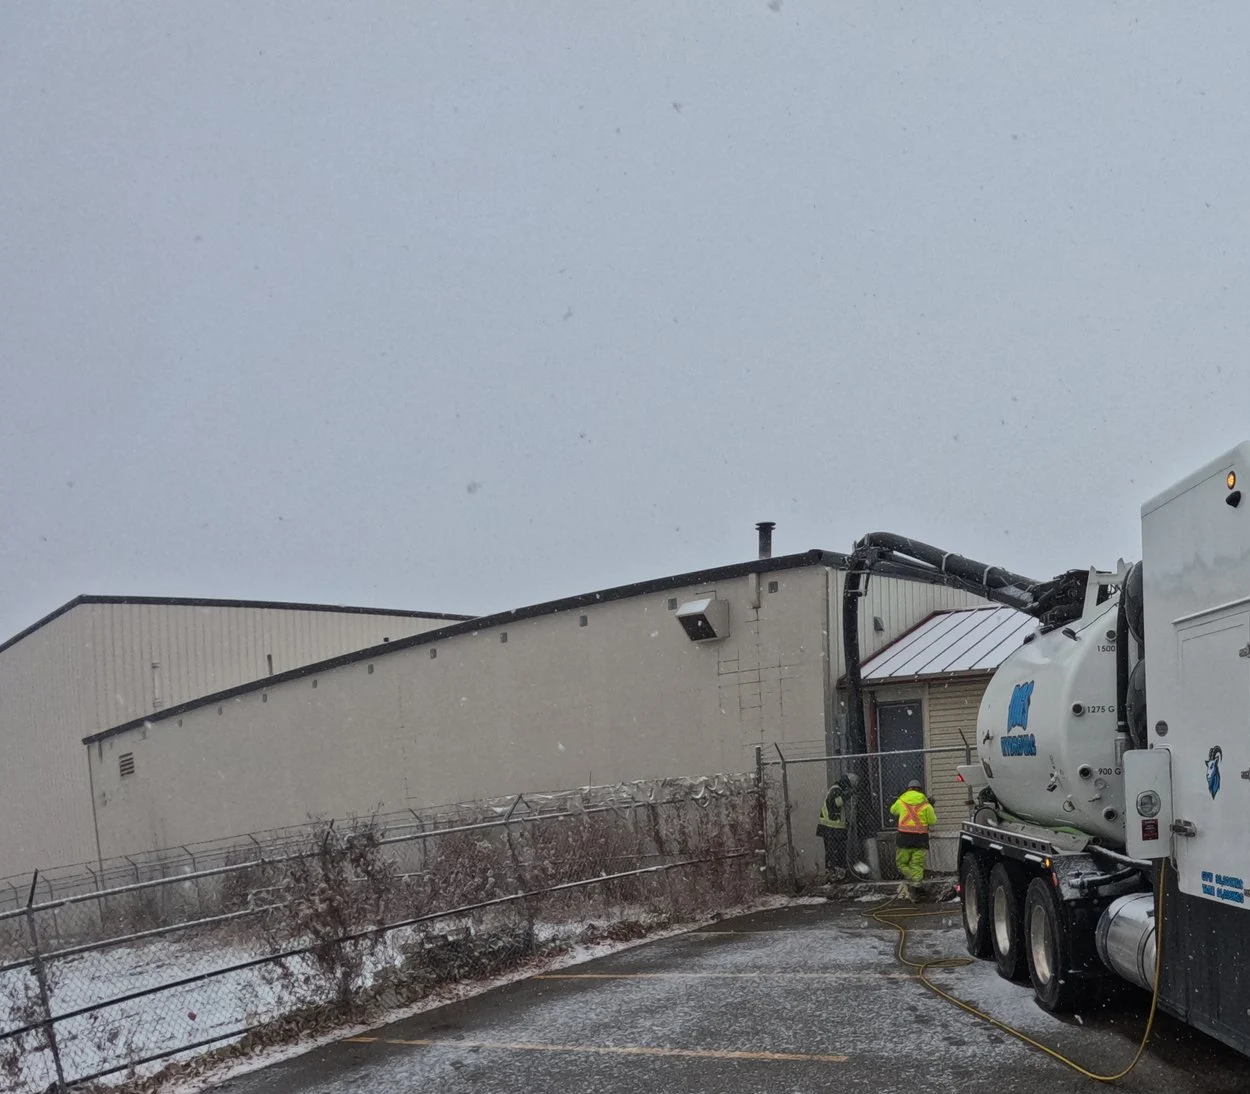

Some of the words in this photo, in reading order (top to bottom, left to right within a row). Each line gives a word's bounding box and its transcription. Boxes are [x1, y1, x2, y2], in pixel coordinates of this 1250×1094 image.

[1087, 705, 1106, 713] 1275
[1098, 768, 1113, 776] 900
[1114, 768, 1121, 776] G
